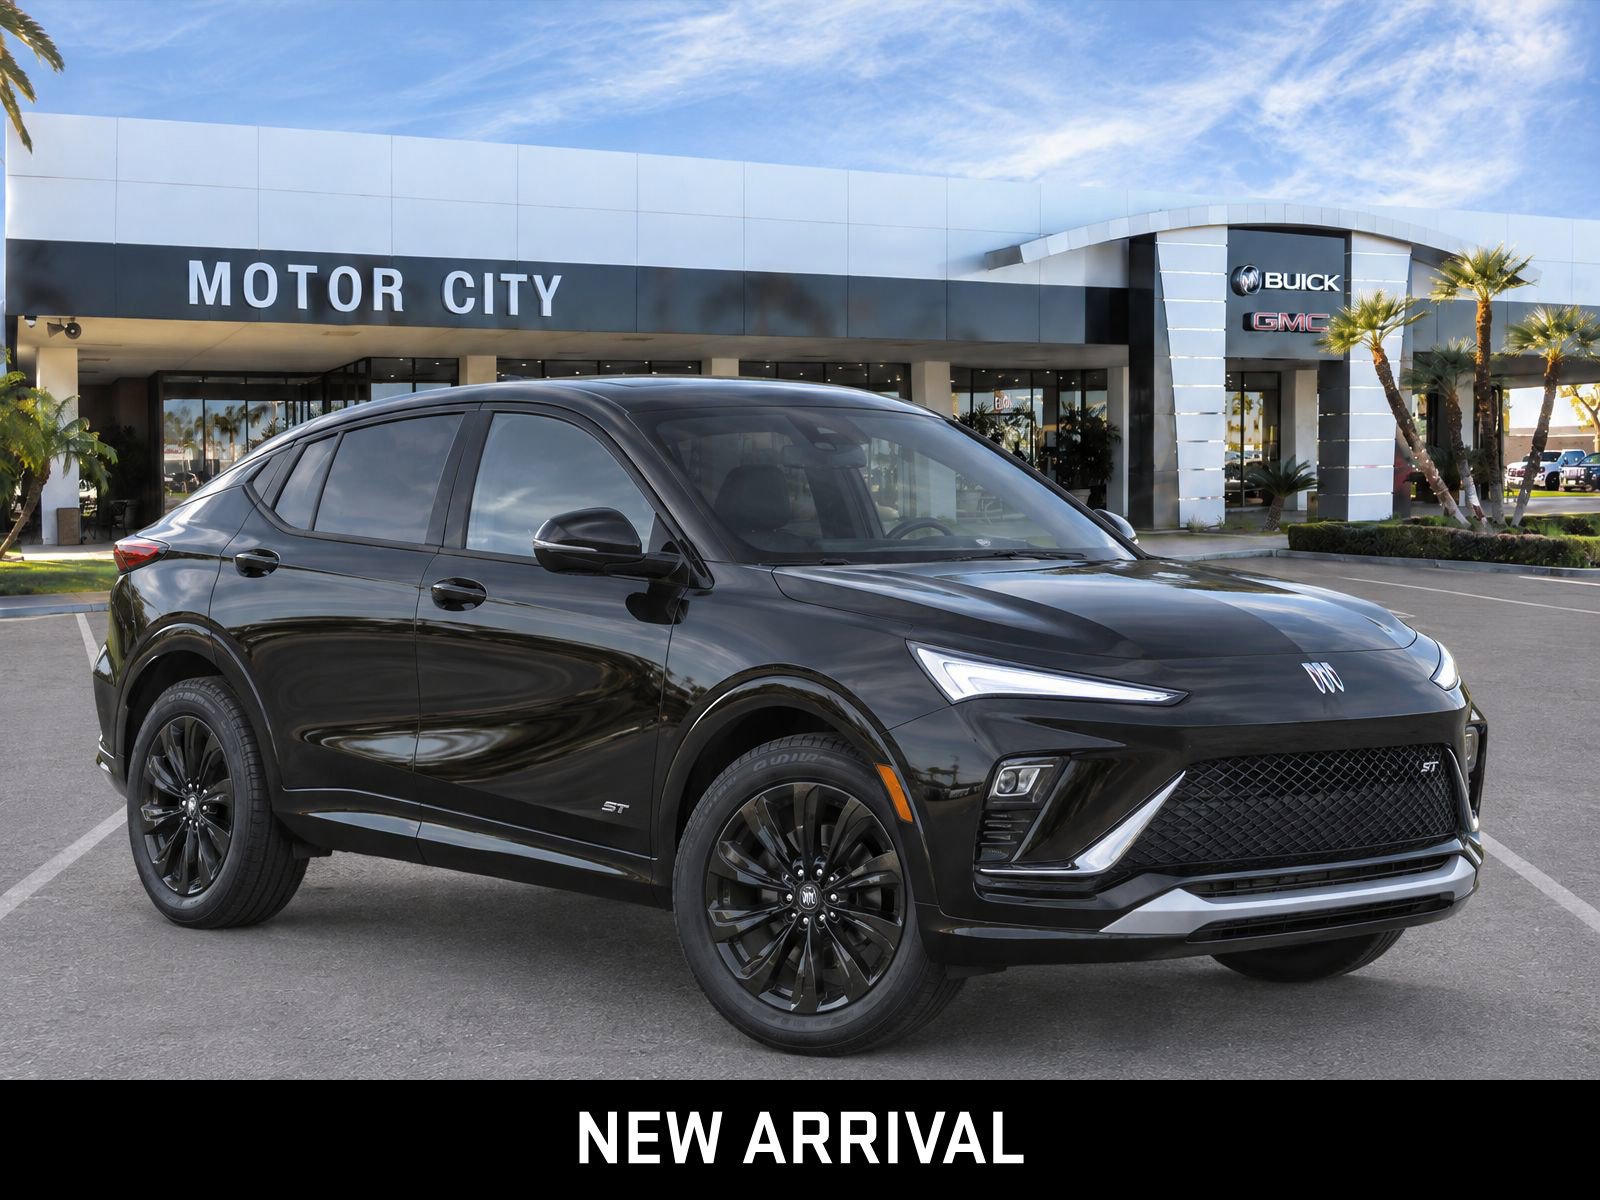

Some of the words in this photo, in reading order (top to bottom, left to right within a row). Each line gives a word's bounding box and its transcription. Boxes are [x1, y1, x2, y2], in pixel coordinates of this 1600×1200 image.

[188, 260, 404, 312] MOTOR
[441, 270, 562, 317] CITY
[1264, 271, 1341, 292] BUICK
[1253, 311, 1330, 332] GMC
[1420, 761, 1439, 773] ST
[601, 801, 630, 814] ST
